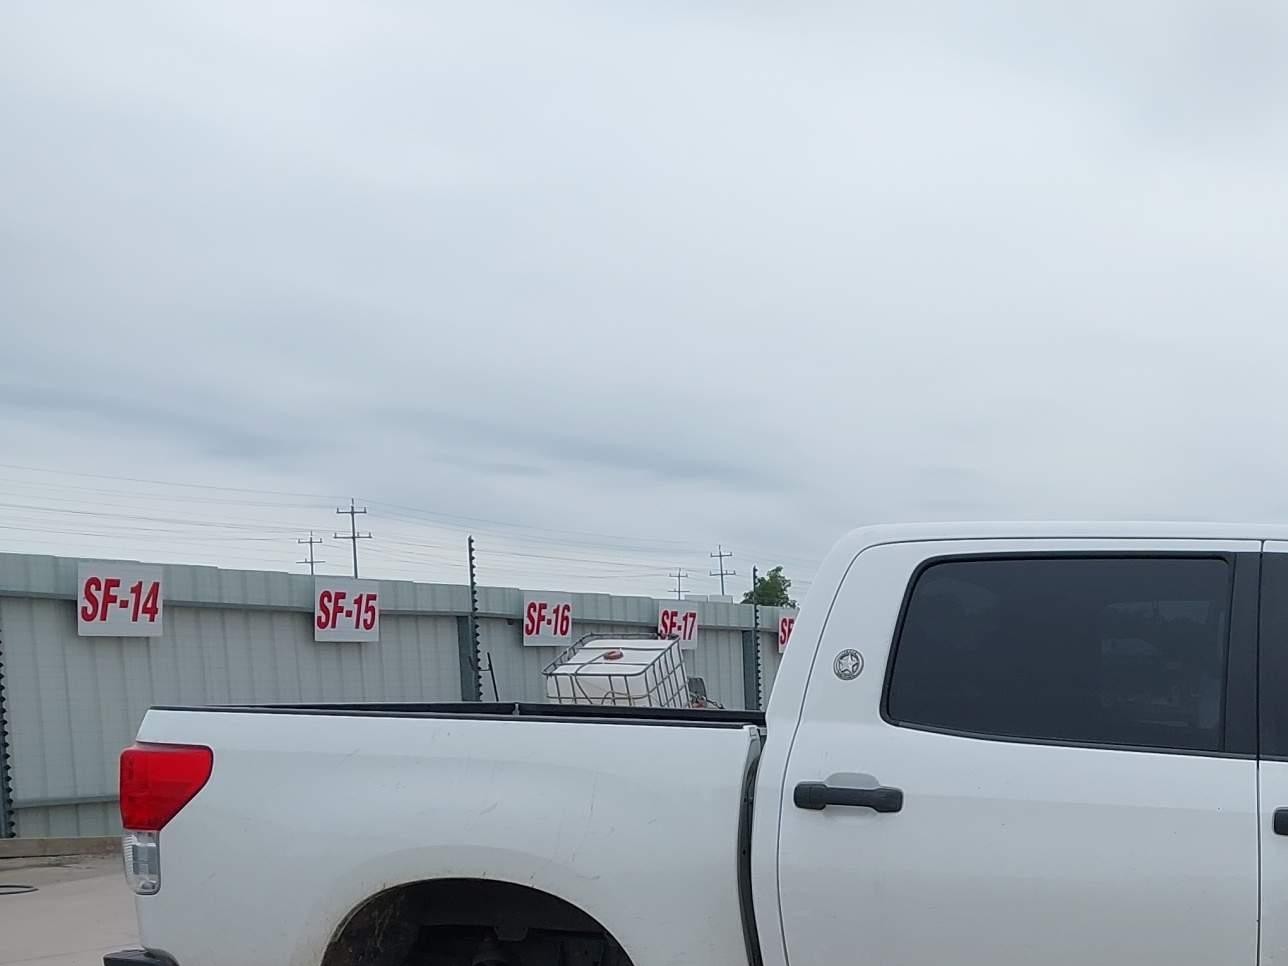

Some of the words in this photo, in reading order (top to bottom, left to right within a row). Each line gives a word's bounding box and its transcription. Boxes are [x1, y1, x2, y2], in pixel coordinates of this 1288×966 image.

[80, 576, 161, 623] SF-14
[316, 590, 378, 631] SF-15
[524, 602, 572, 636] SF-16
[660, 609, 697, 641] SF-17
